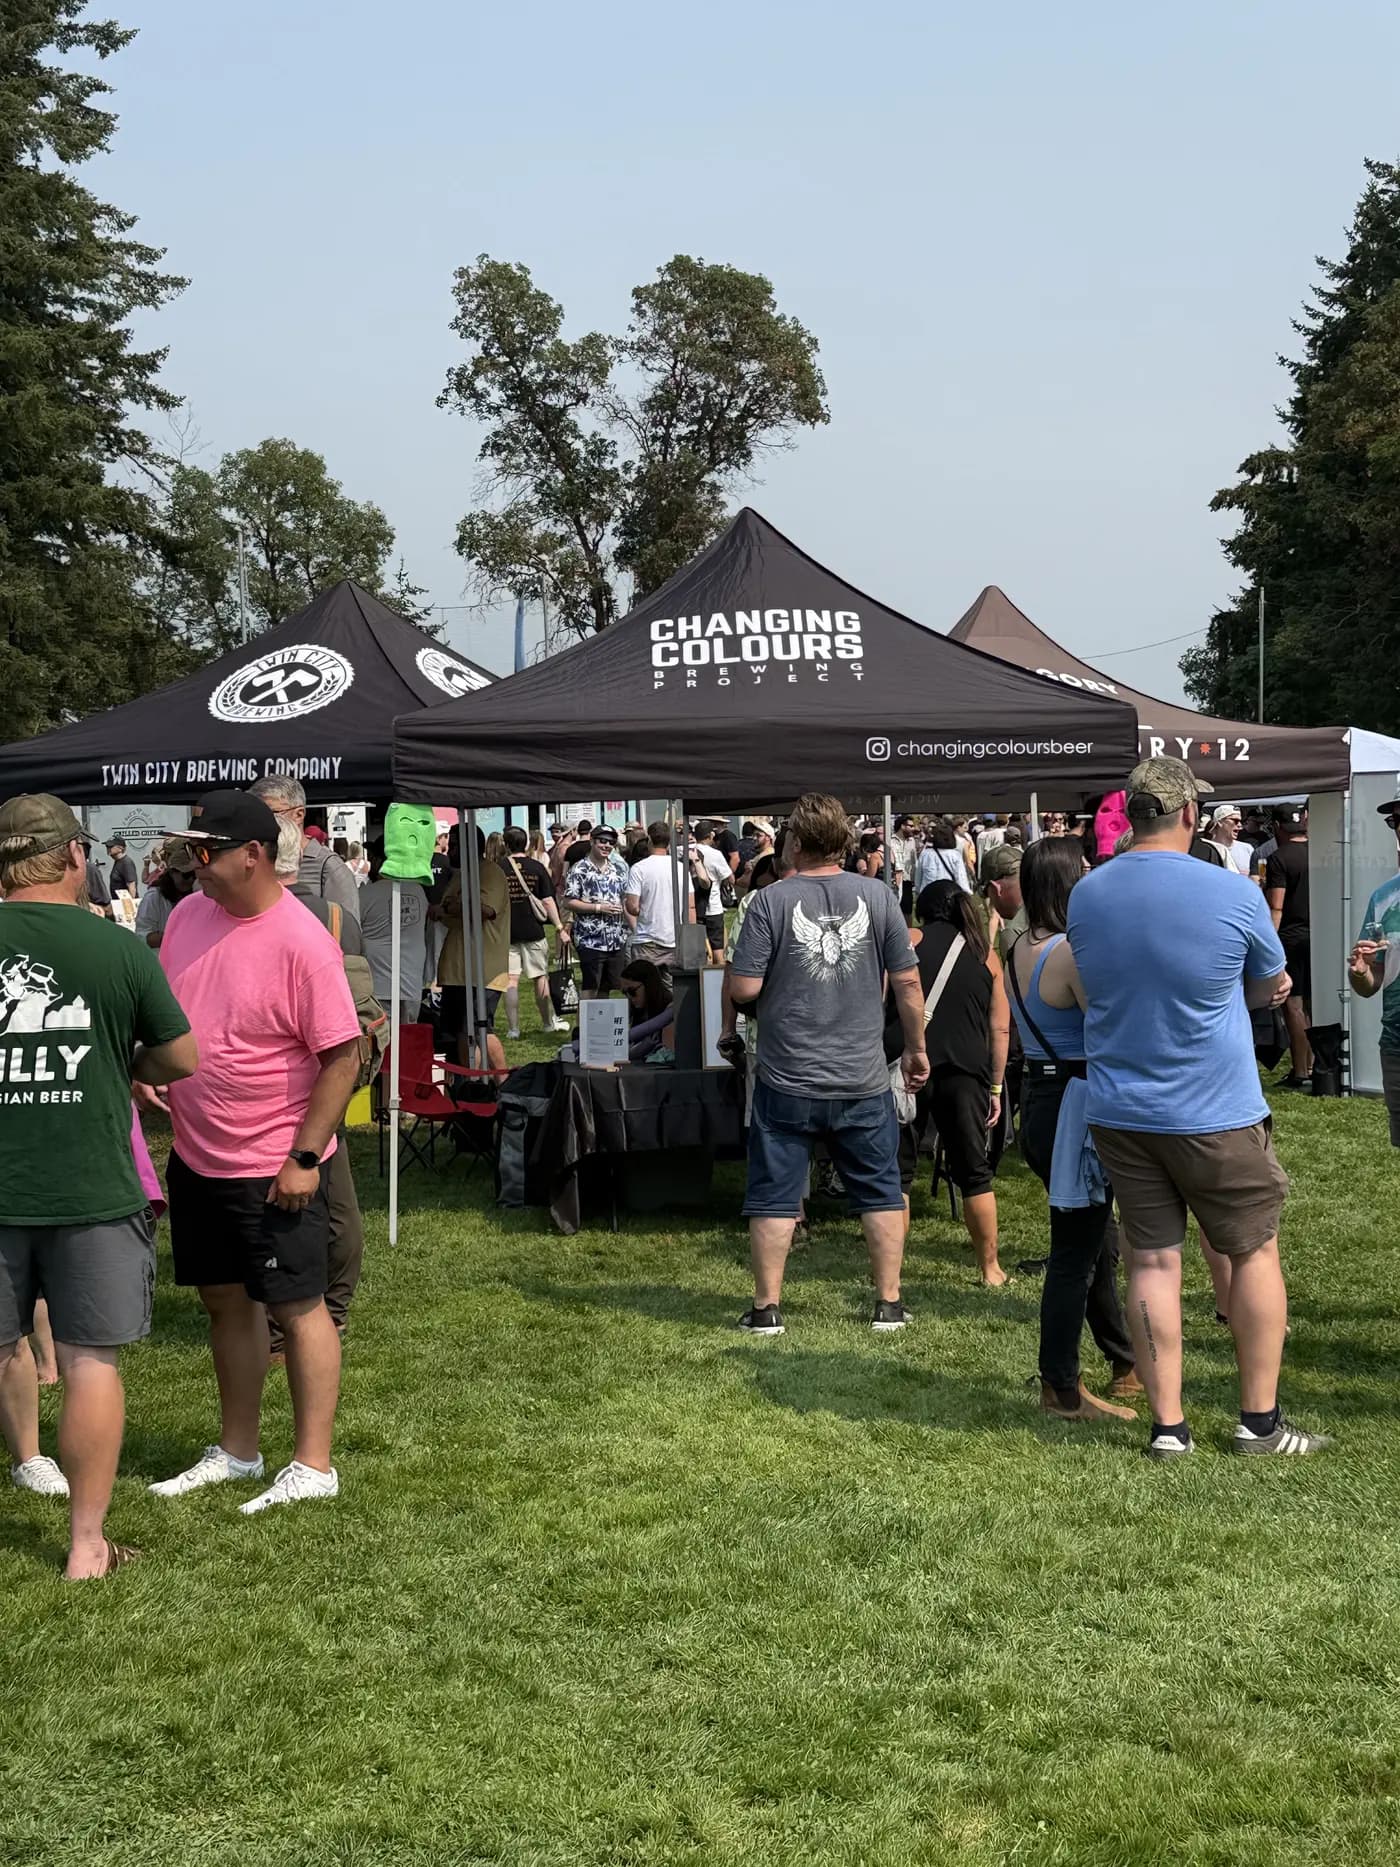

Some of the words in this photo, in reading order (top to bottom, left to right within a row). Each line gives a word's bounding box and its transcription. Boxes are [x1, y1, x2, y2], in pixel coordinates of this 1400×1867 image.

[650, 609, 861, 641] CHANGING
[254, 650, 299, 671] TWIN
[304, 651, 340, 671] CITY
[651, 634, 864, 667] COLOURS
[653, 663, 862, 679] BREWING
[653, 673, 864, 689] PROJECT
[1030, 667, 1118, 694] GORY
[226, 704, 299, 716] BREWING
[897, 739, 1094, 759] changingcoloursbeer
[1138, 737, 1193, 759] RY
[1217, 738, 1250, 761] 12
[102, 764, 140, 786] TWIN
[145, 761, 181, 784] CITY
[186, 758, 258, 782] BREWING
[264, 757, 342, 781] COMPANY
[0, 1091, 34, 1104] IAN
[40, 1090, 83, 1103] BEER
